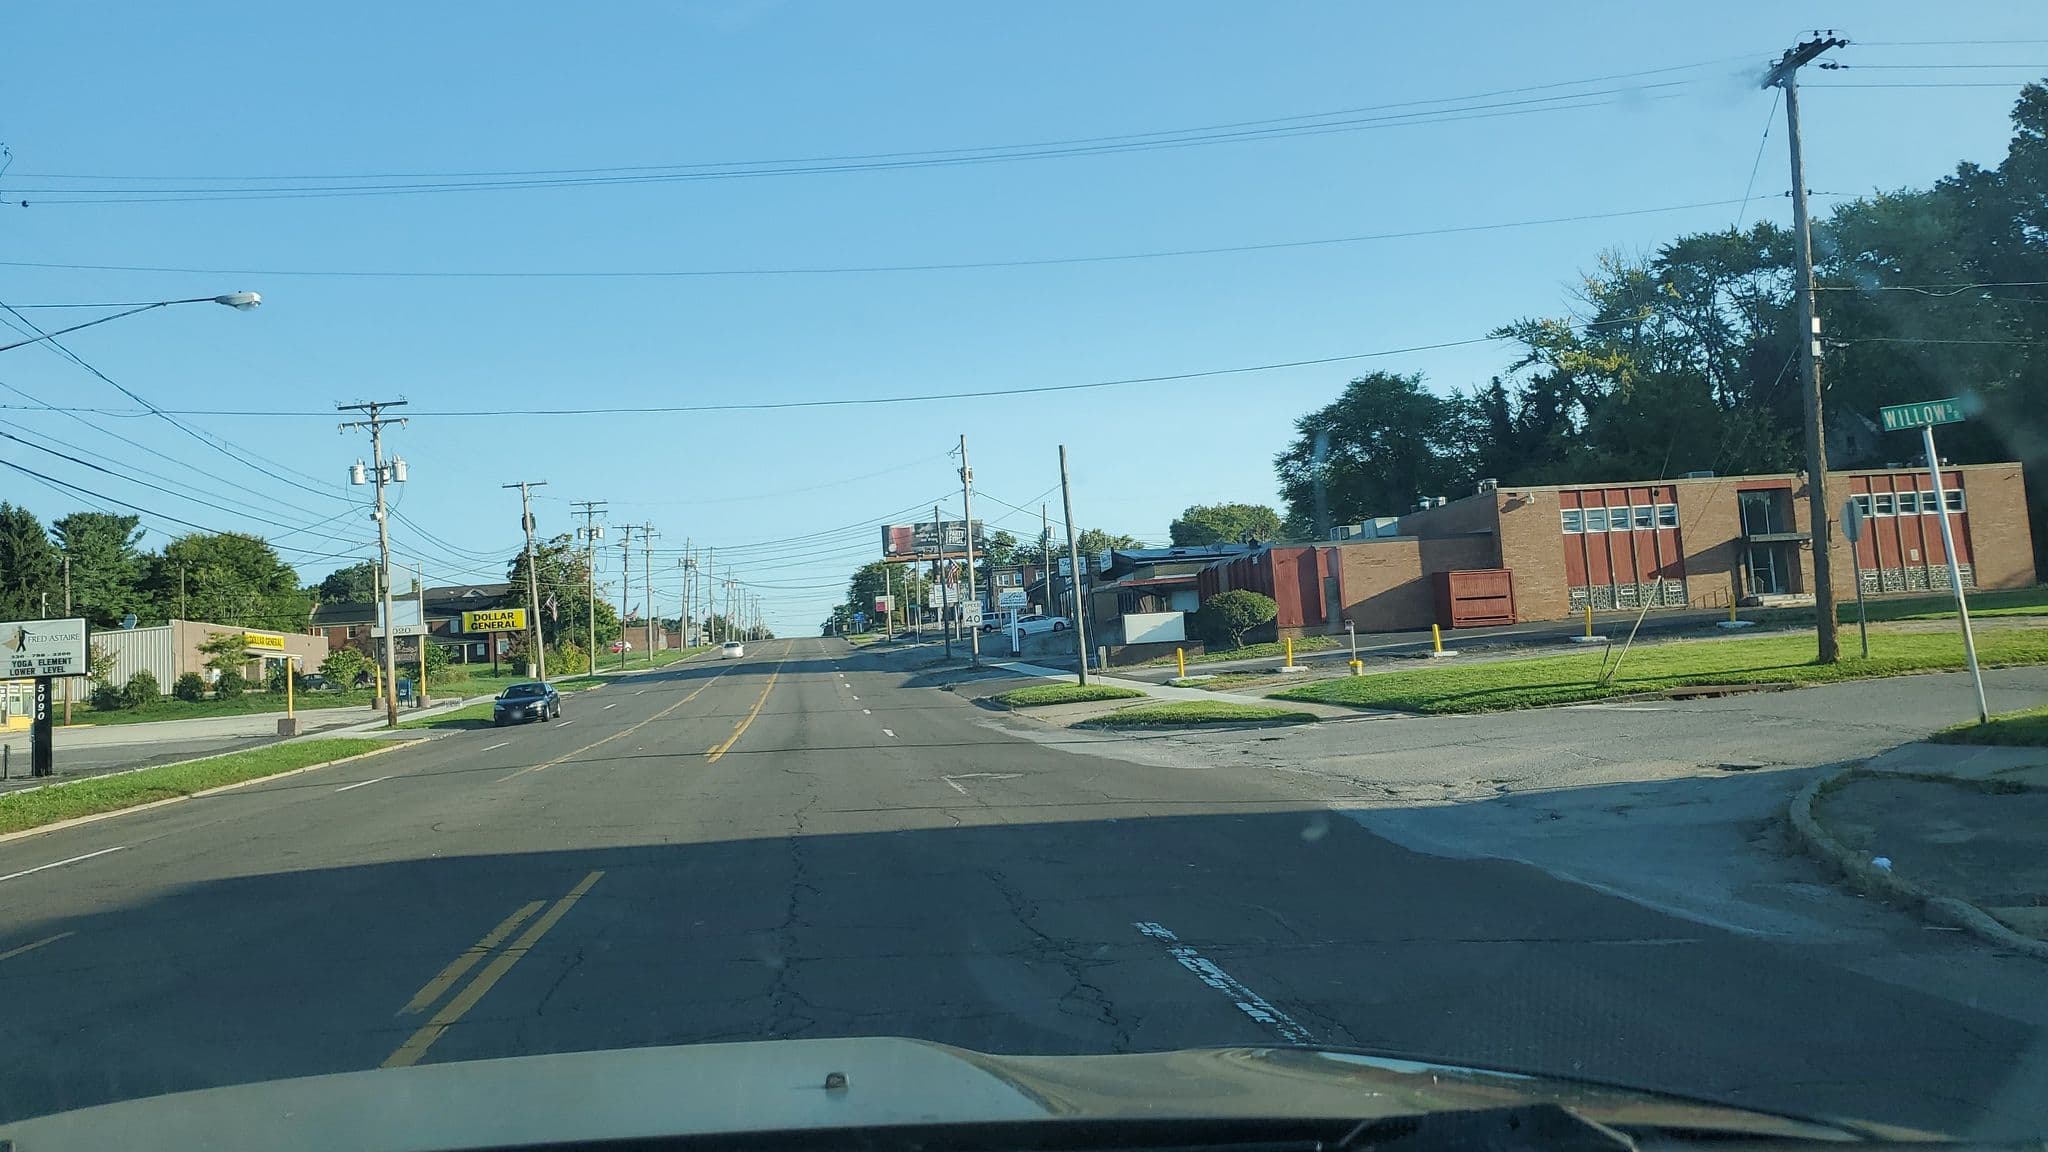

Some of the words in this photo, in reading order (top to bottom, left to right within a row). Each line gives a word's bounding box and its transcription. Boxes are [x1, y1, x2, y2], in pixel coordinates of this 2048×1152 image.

[1883, 404, 1945, 428] WILLOW
[473, 612, 514, 622] DOLLAR
[965, 614, 980, 623] 40
[470, 621, 518, 630] GENERAL
[28, 635, 47, 643] FRED
[49, 633, 81, 642] ASTAIRE
[11, 659, 33, 668] YOGA
[38, 657, 73, 666] ELEMENT
[9, 667, 36, 676] LOWER
[43, 665, 66, 674] LEVEL
[37, 684, 45, 720] 5090
